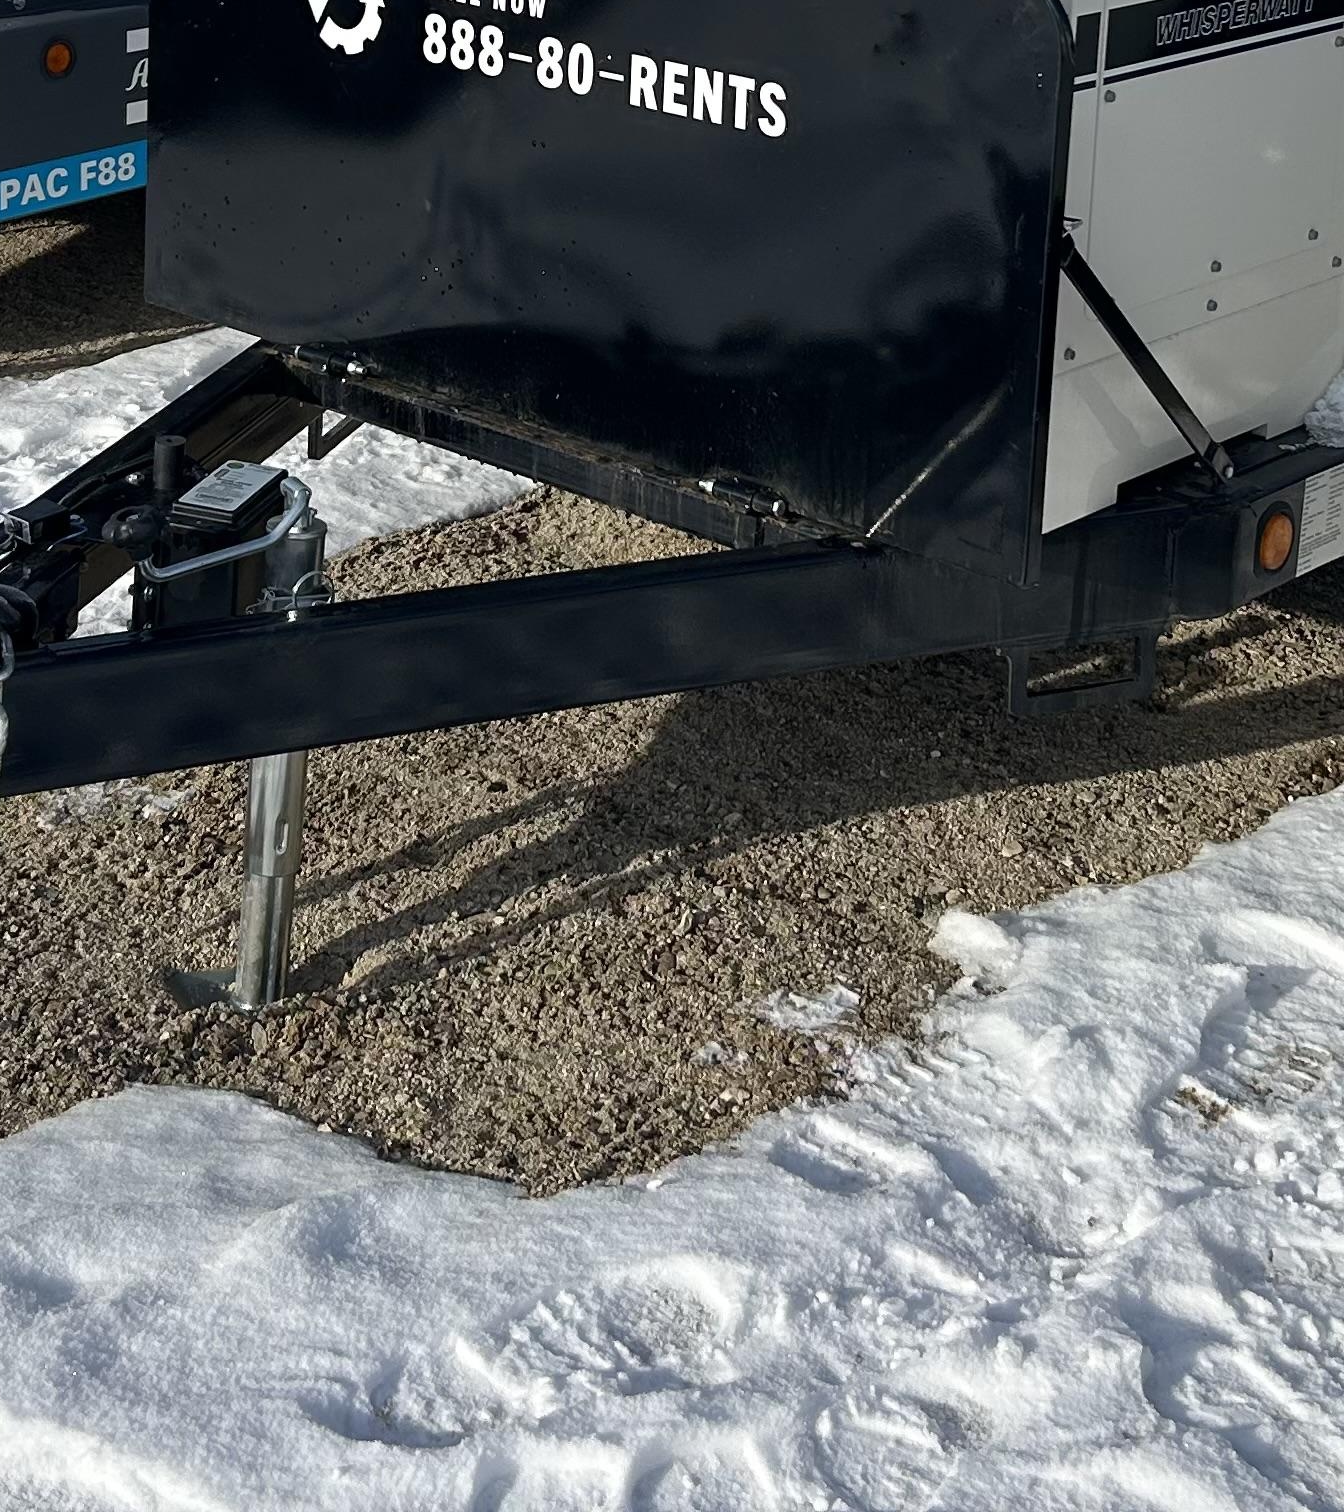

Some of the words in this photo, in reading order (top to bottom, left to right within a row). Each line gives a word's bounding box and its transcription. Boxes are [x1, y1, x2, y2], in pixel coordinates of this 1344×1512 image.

[422, 13, 789, 139] 888-80-RENTS
[0, 167, 69, 212] PAC
[80, 151, 137, 192] F88
